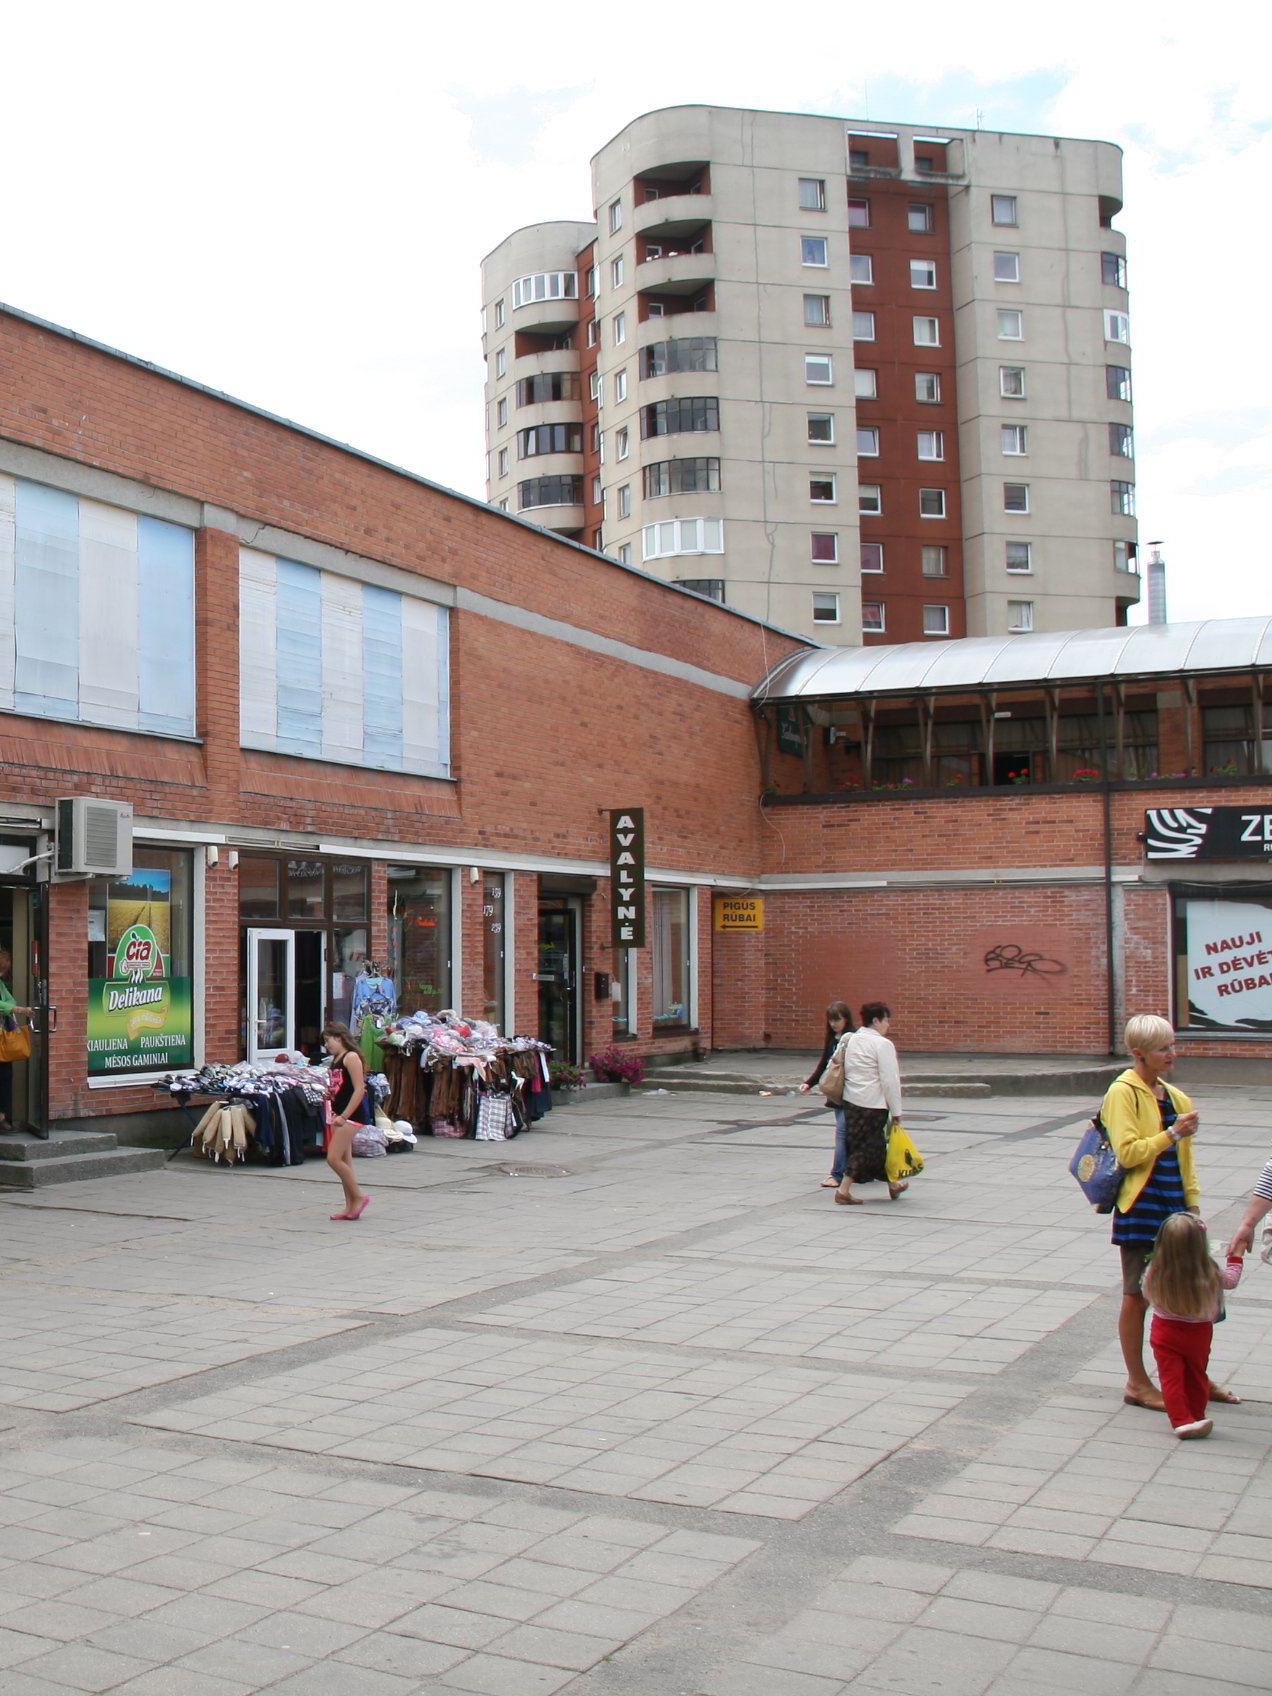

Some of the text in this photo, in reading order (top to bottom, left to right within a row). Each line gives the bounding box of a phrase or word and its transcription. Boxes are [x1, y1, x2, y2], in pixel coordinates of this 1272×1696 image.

[616, 815, 636, 941] AVALYNĖ
[1205, 931, 1262, 955] NAUJI
[1194, 966, 1215, 980] IR
[109, 986, 163, 1011] Delikana
[140, 1034, 186, 1048] PAUKŠTIENA
[104, 1052, 168, 1069] MĖSOS GAMINIAI
